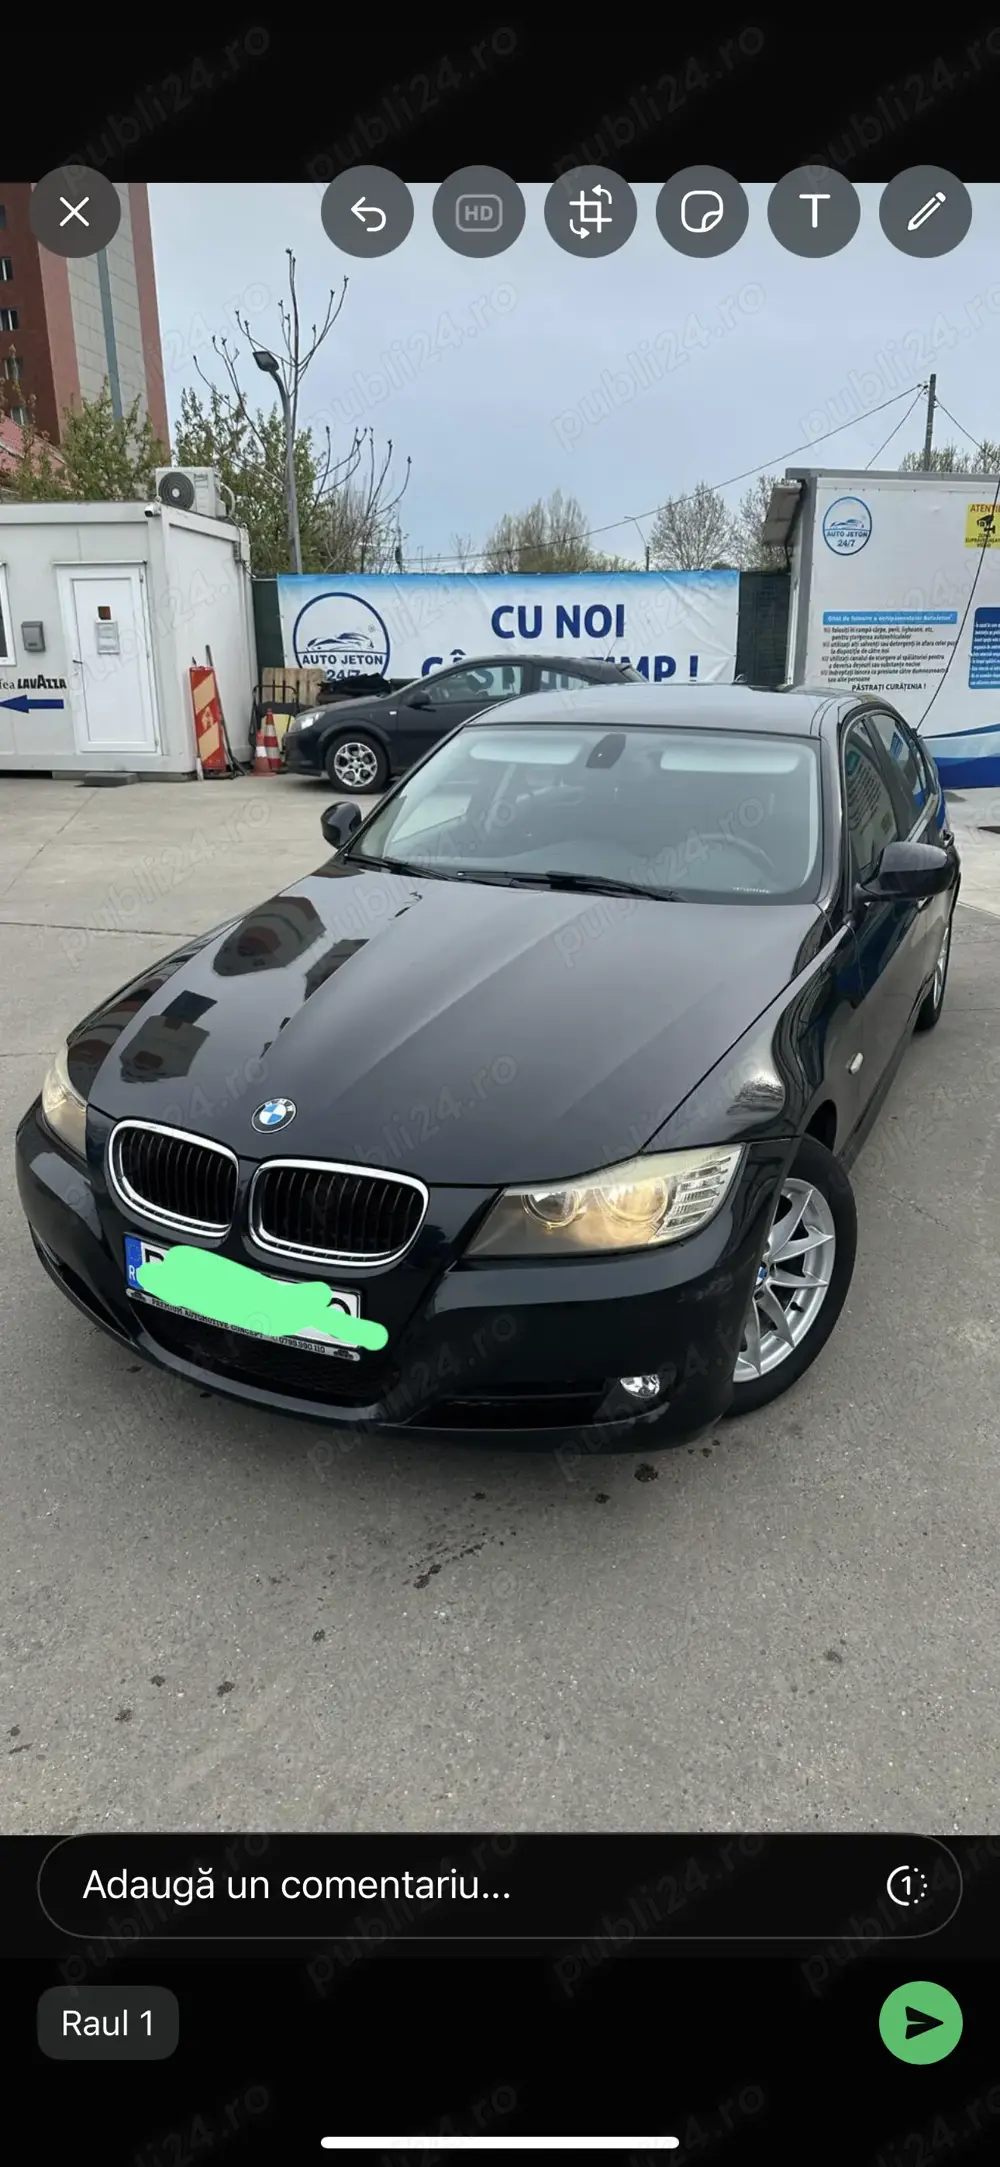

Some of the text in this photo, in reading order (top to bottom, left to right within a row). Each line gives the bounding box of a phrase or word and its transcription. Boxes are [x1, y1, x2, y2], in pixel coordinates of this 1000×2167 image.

[837, 539, 855, 547] 24/7
[491, 604, 624, 639] CU NOI
[302, 655, 383, 665] AUTO JETON
[17, 674, 67, 689] LAVAZZA
